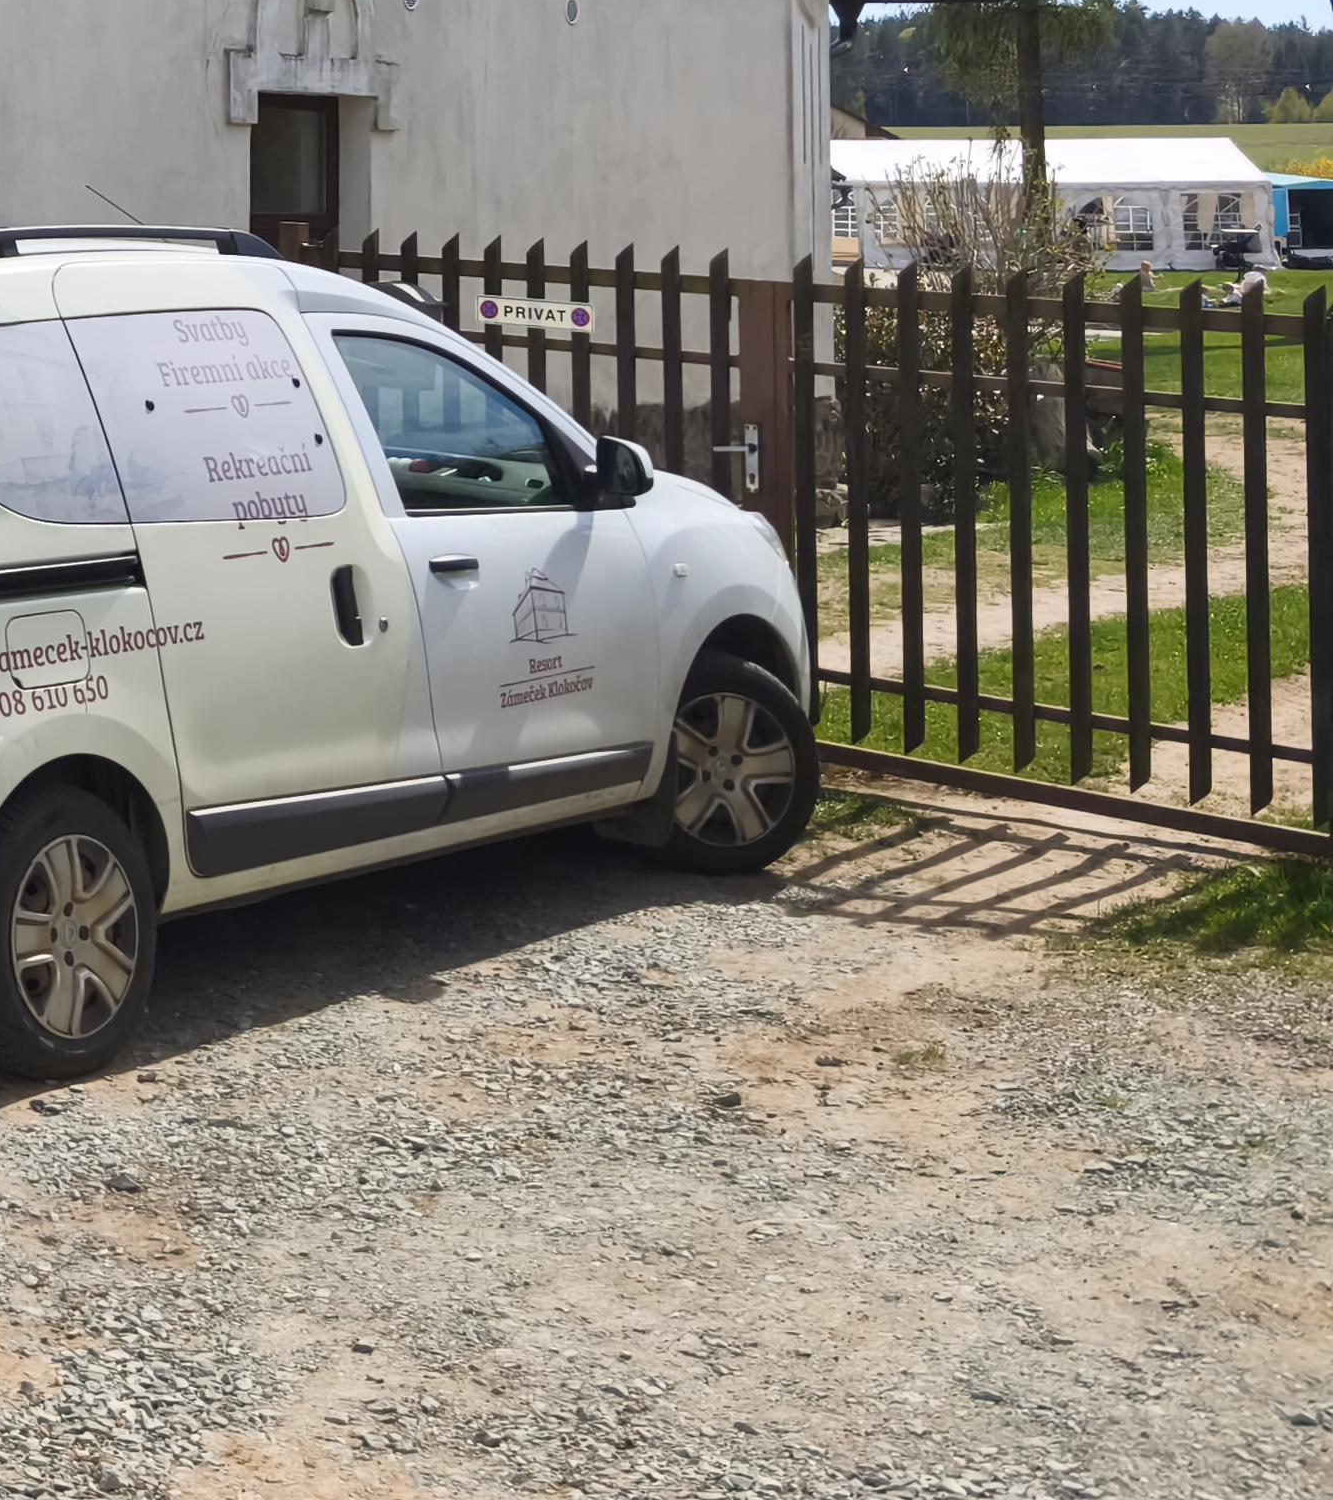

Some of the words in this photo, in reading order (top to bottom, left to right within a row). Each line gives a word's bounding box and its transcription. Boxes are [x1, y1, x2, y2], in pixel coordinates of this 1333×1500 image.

[503, 305, 566, 322] PRIVAT
[173, 315, 250, 346] Svatby
[156, 353, 244, 387] Firemní
[246, 354, 293, 381] akce
[203, 442, 313, 482] Rekreační
[232, 491, 309, 529] pobyty
[529, 655, 563, 674] Resort
[31, 686, 68, 712] 610
[73, 674, 109, 704] 650
[500, 683, 547, 708] Zámeček
[548, 675, 594, 698] Klokočov
